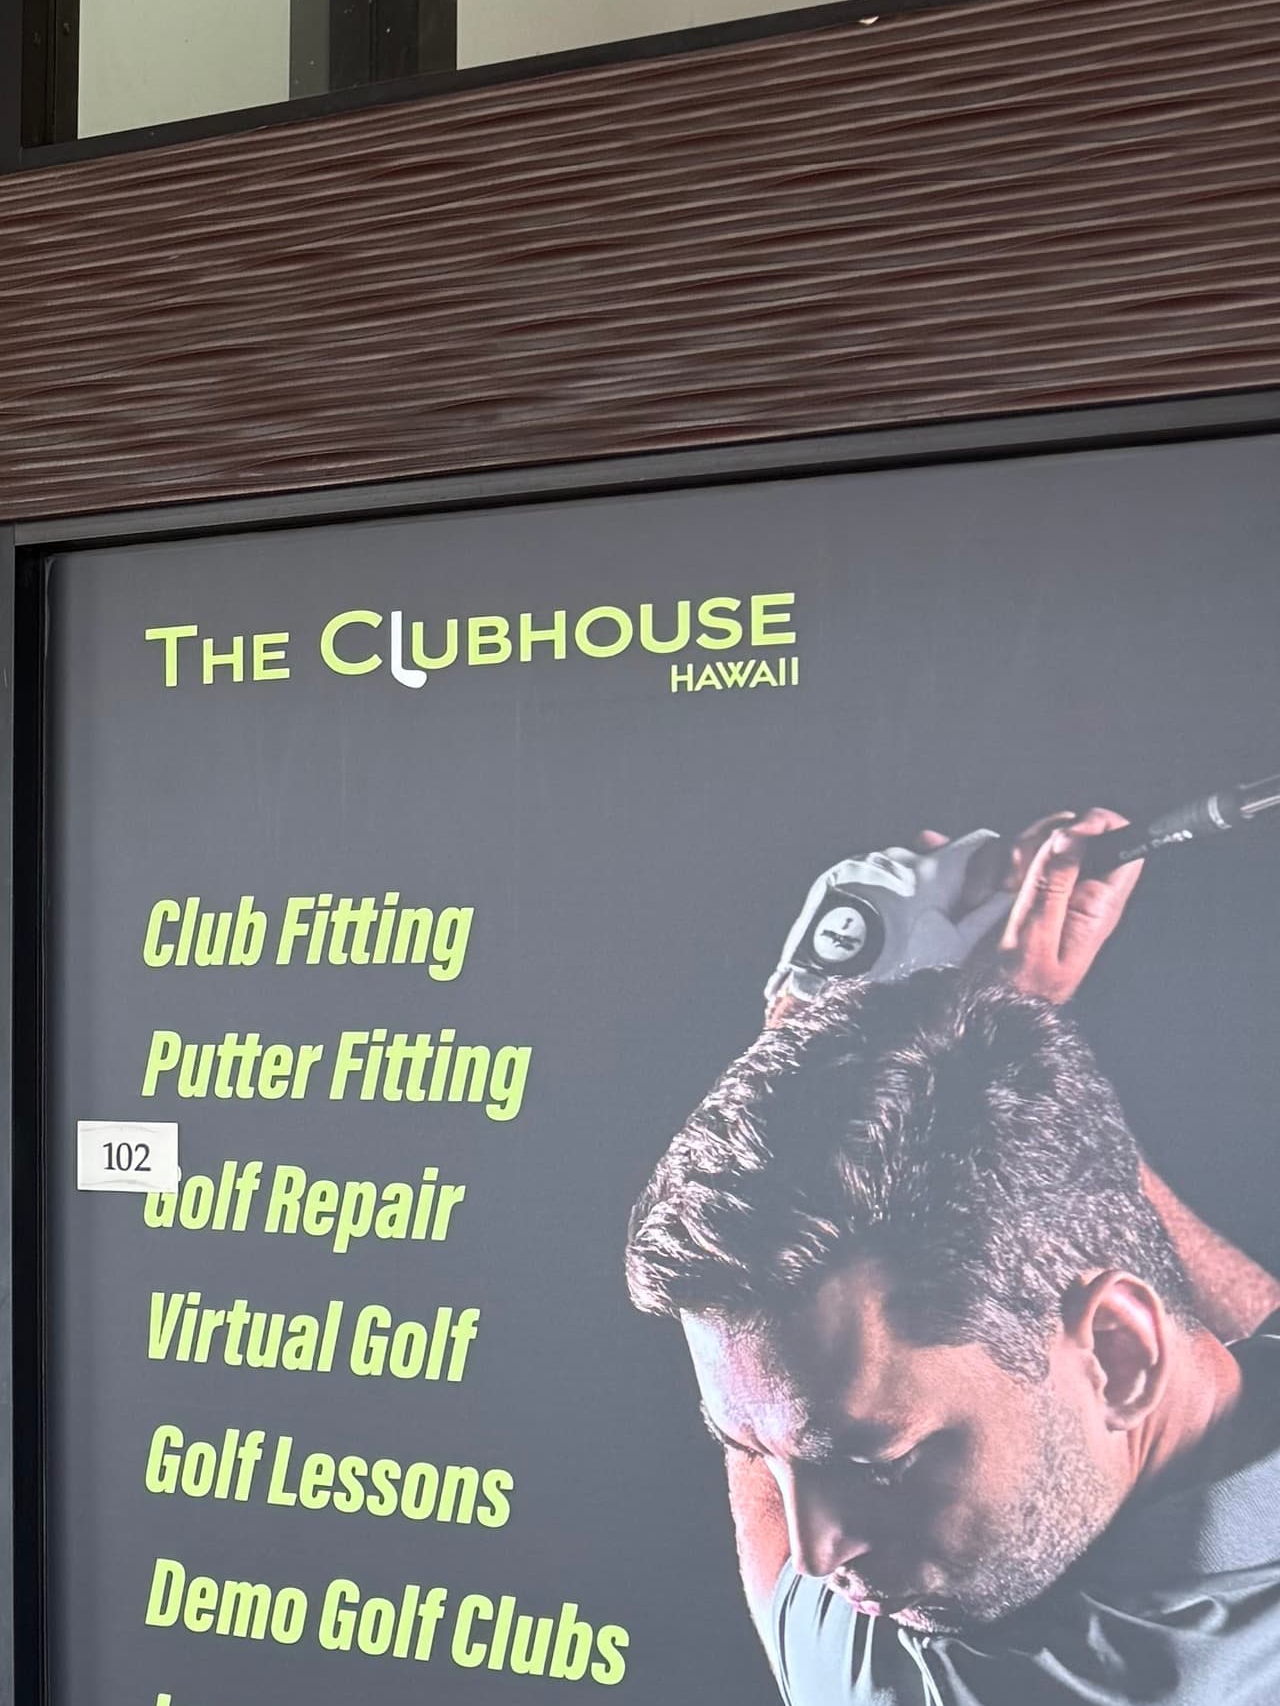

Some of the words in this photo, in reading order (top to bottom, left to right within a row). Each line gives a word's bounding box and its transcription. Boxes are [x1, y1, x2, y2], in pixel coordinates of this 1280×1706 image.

[145, 625, 290, 687] THE
[320, 592, 796, 689] CLUBHOUSE
[671, 656, 799, 693] HAWAII
[143, 895, 267, 967] Club
[275, 891, 475, 981] Fitting
[141, 1030, 324, 1099] Putter
[329, 1027, 533, 1121] Fitting
[102, 1142, 152, 1172] 102
[265, 1165, 466, 1254] Repair
[148, 1292, 344, 1372] Virtual
[350, 1305, 481, 1382] Golf
[145, 1425, 266, 1501] Golf
[267, 1436, 514, 1528] Lessons
[145, 1558, 308, 1644] Demo
[318, 1579, 448, 1661] Golf
[452, 1594, 629, 1685] Clubs
